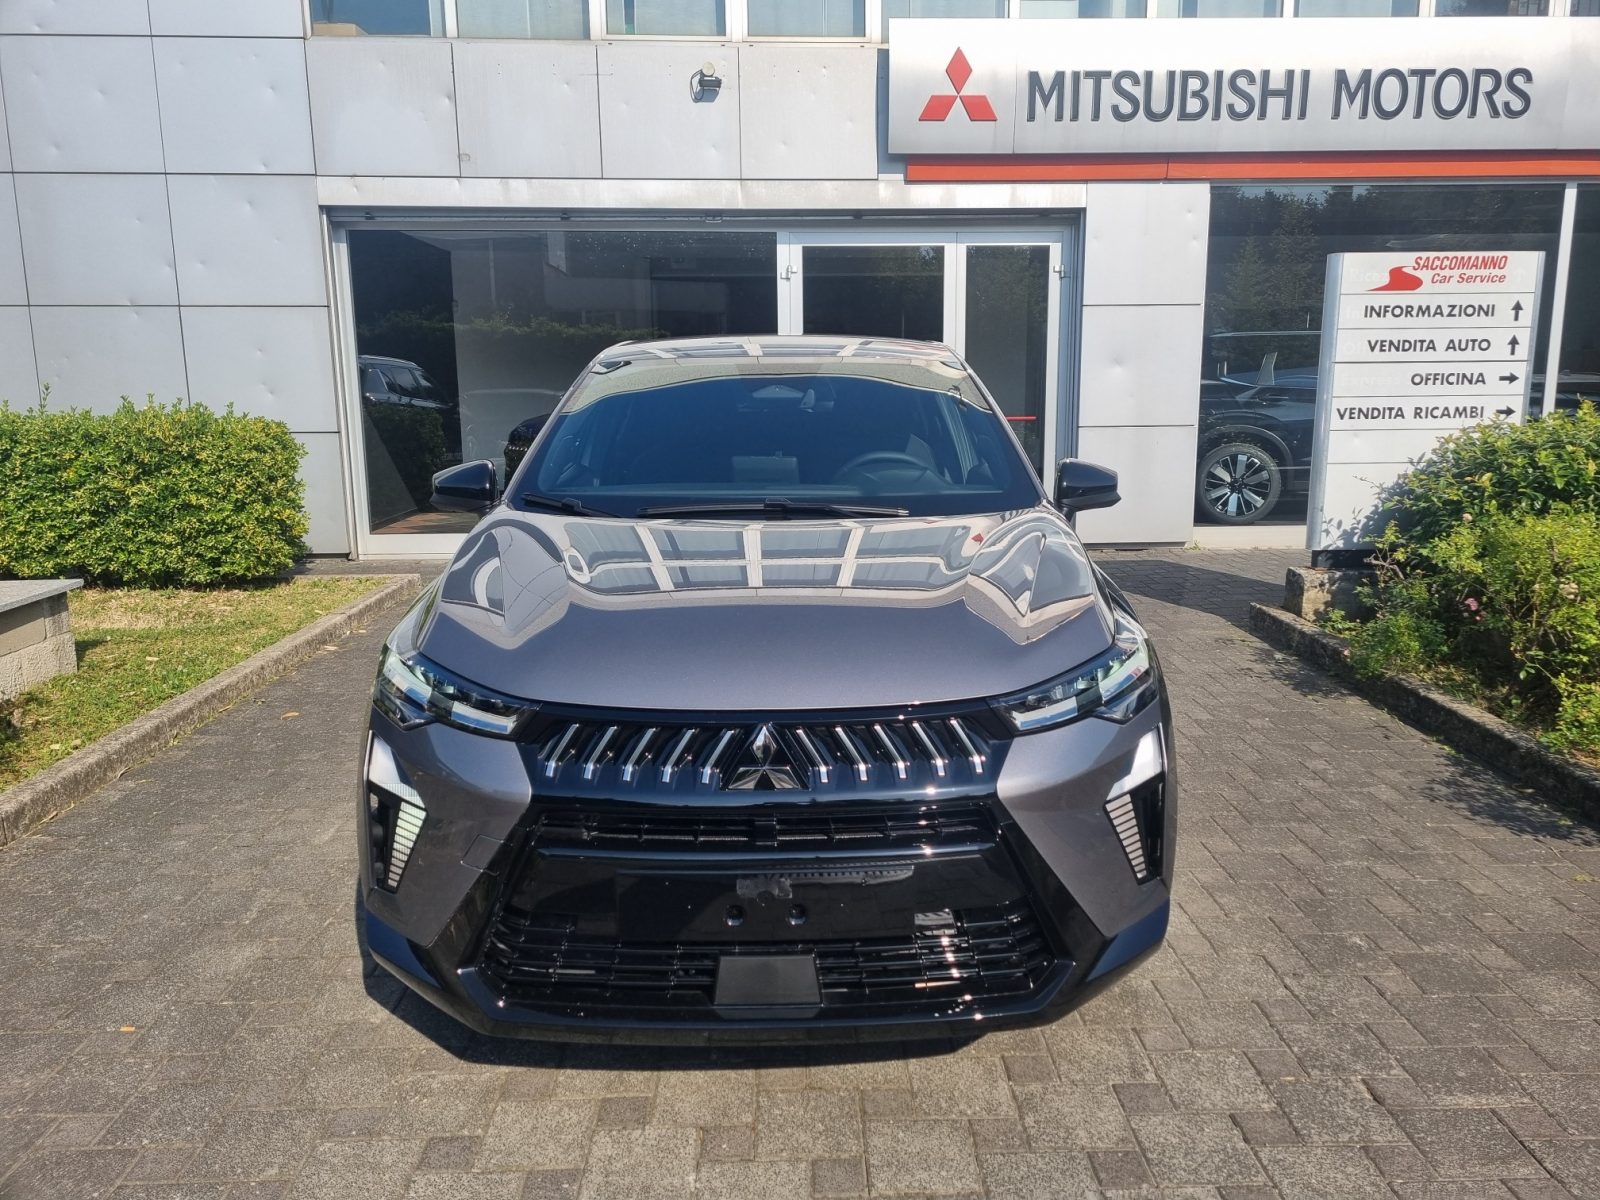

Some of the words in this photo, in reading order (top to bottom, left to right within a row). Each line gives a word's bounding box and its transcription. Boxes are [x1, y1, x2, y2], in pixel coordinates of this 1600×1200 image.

[1026, 69, 1311, 122] MITSUBISHI
[1331, 67, 1533, 121] MOTORS
[1412, 255, 1508, 271] SACCOMANNO
[1431, 272, 1454, 284] Car
[1456, 272, 1507, 284] Service
[1364, 304, 1496, 318] INFORMAZIONI
[1367, 339, 1437, 352] VENDITA
[1445, 338, 1491, 352] AUTO
[1410, 372, 1487, 386] OFFICINA
[1336, 406, 1405, 420] VENDITA
[1413, 405, 1484, 420] RICAMBI
